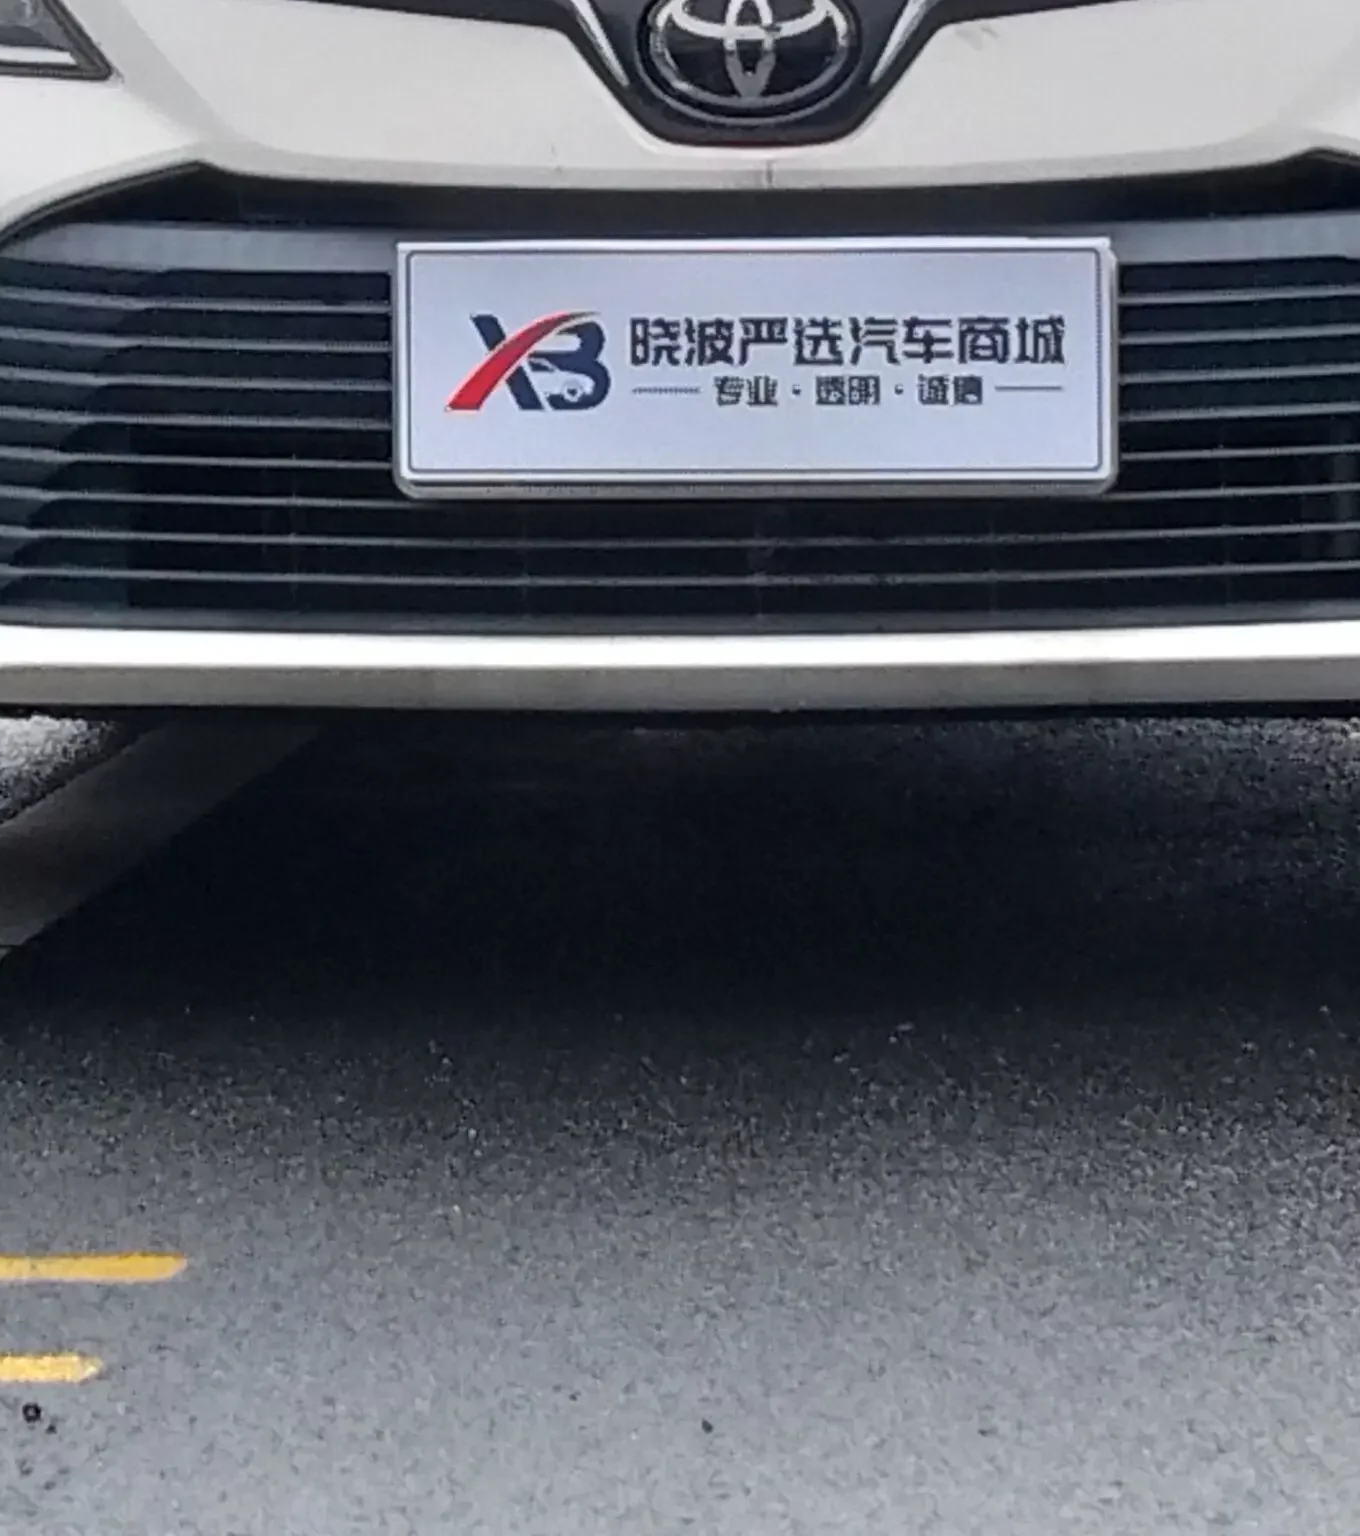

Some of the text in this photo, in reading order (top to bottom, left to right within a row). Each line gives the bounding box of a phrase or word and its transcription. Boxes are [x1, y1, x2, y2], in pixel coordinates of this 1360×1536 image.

[630, 316, 1065, 366] 晓波严选汽车商城
